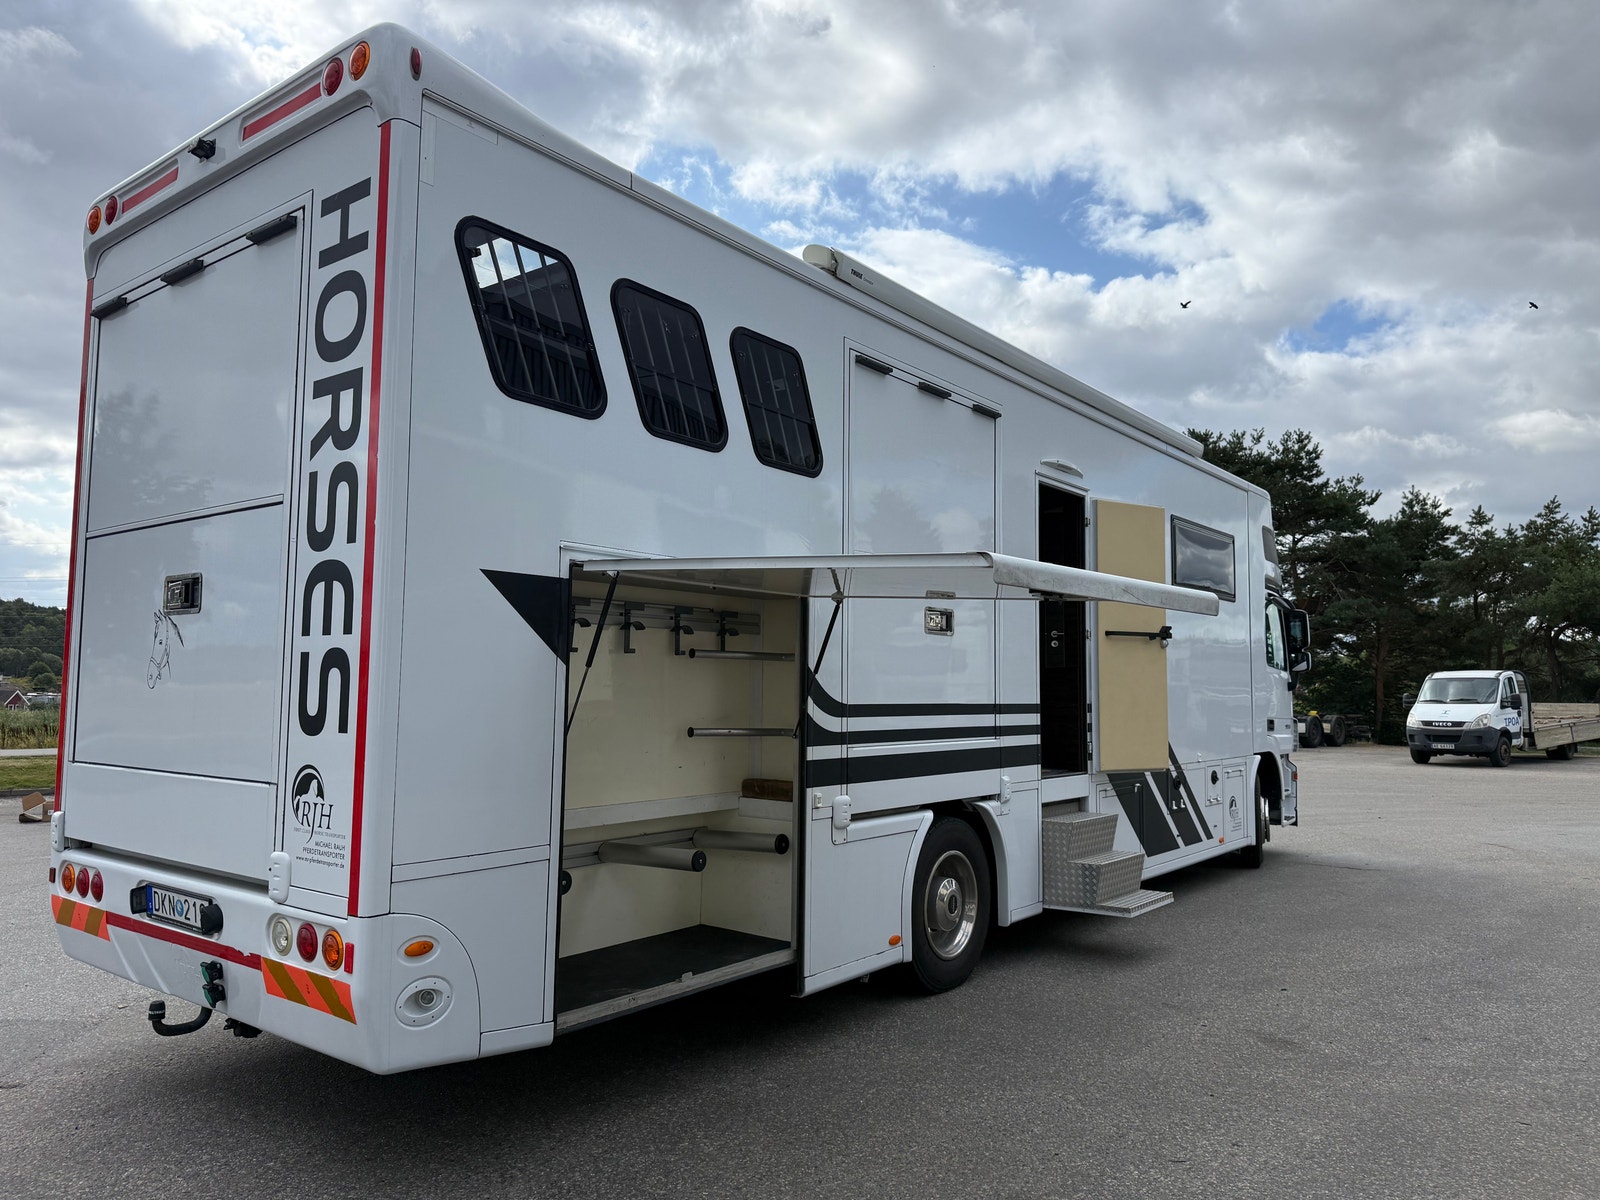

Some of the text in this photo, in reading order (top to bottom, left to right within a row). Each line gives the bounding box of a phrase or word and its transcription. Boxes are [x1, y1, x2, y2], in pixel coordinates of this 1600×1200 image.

[297, 176, 372, 736] HORSES
[301, 801, 334, 844] RJH
[302, 846, 345, 861] PFERDETRANSPORTER
[315, 840, 333, 850] MICHAEL
[153, 890, 176, 917] DKN
